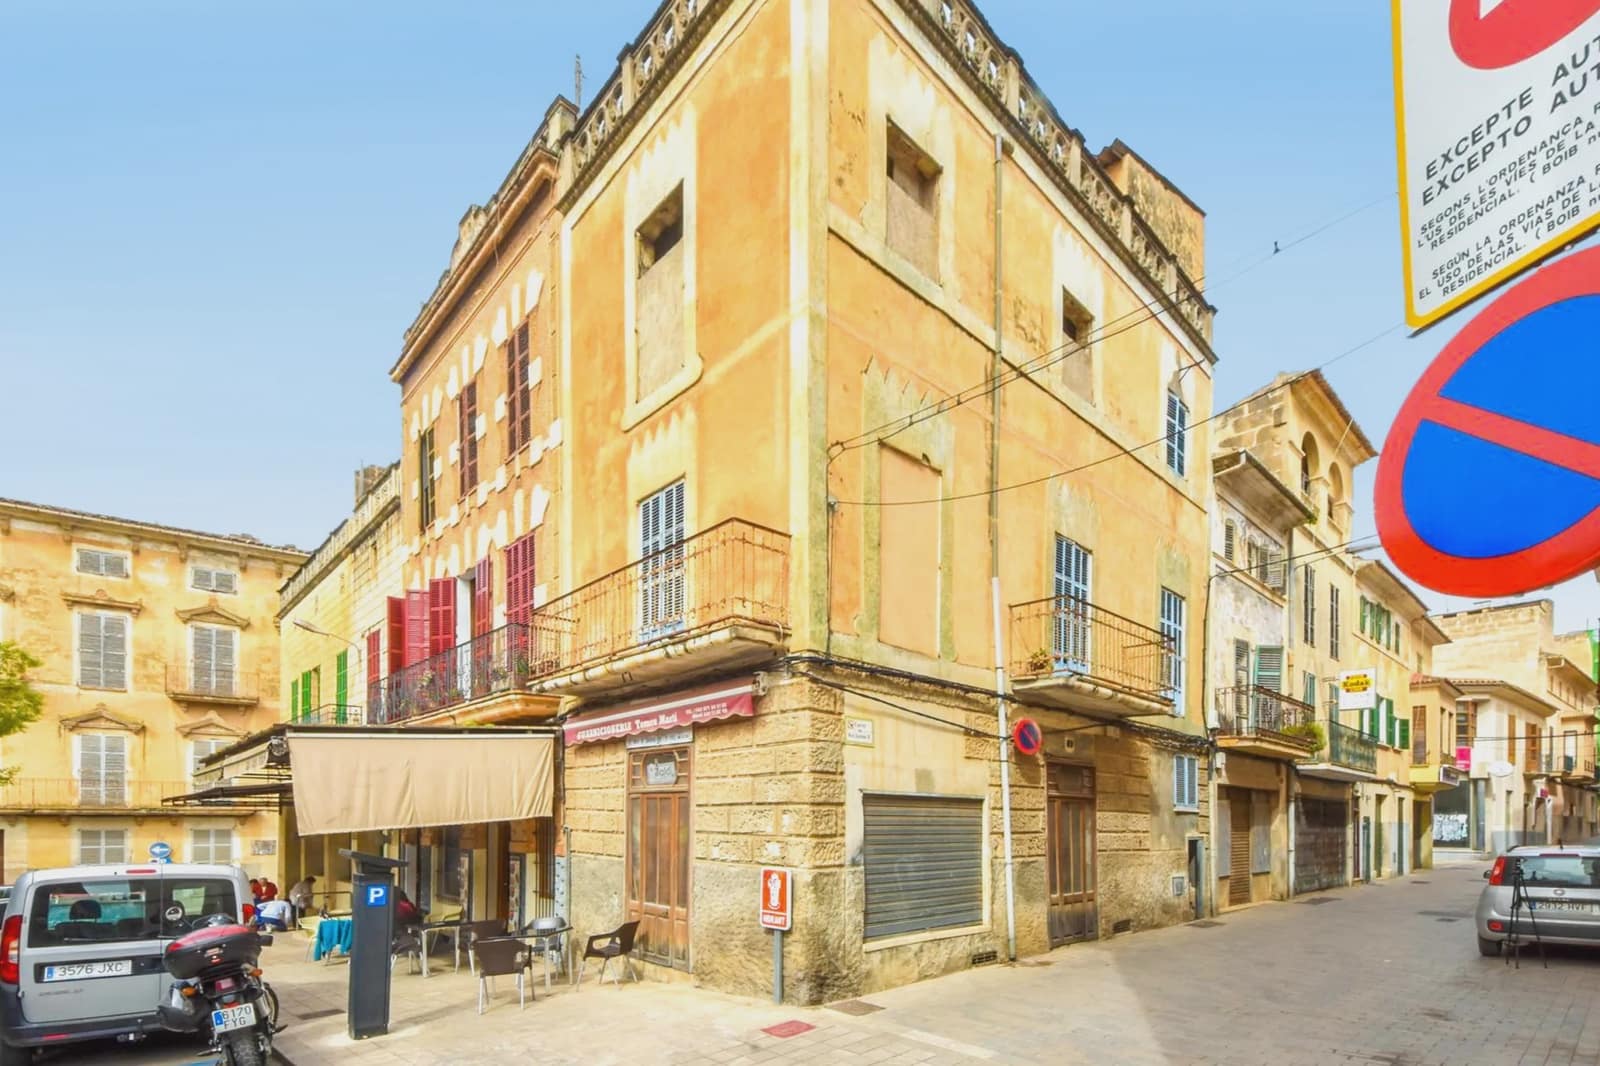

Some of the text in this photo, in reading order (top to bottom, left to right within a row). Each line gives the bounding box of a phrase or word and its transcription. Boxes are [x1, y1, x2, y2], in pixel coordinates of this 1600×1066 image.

[1422, 115, 1532, 206] EXCEPTO
[1426, 86, 1533, 180] EXCEPTE
[1449, 209, 1465, 226] DE
[1472, 187, 1496, 210] LES
[1505, 159, 1536, 186] VIES
[1546, 139, 1565, 160] DE
[1575, 121, 1594, 140] LA
[1420, 193, 1471, 235] SEGONS
[1431, 189, 1520, 250] RESIDENCIAL.
[1542, 144, 1578, 175] BOIB
[1476, 235, 1491, 252] LA
[1498, 175, 1585, 235] ORDENANZA
[1419, 287, 1431, 299] EL
[1437, 267, 1461, 288] USO
[1467, 252, 1482, 269] DE
[1490, 232, 1514, 255] LAS
[1522, 208, 1552, 233] VIAS
[1562, 190, 1580, 210] DE
[1443, 243, 1526, 297] RESIDENCIAL.
[1547, 205, 1580, 232] BOIB
[370, 888, 384, 903] P
[58, 962, 123, 977] 3576 JXC
[222, 1005, 252, 1020] 6170
[223, 1016, 247, 1030] FYG
